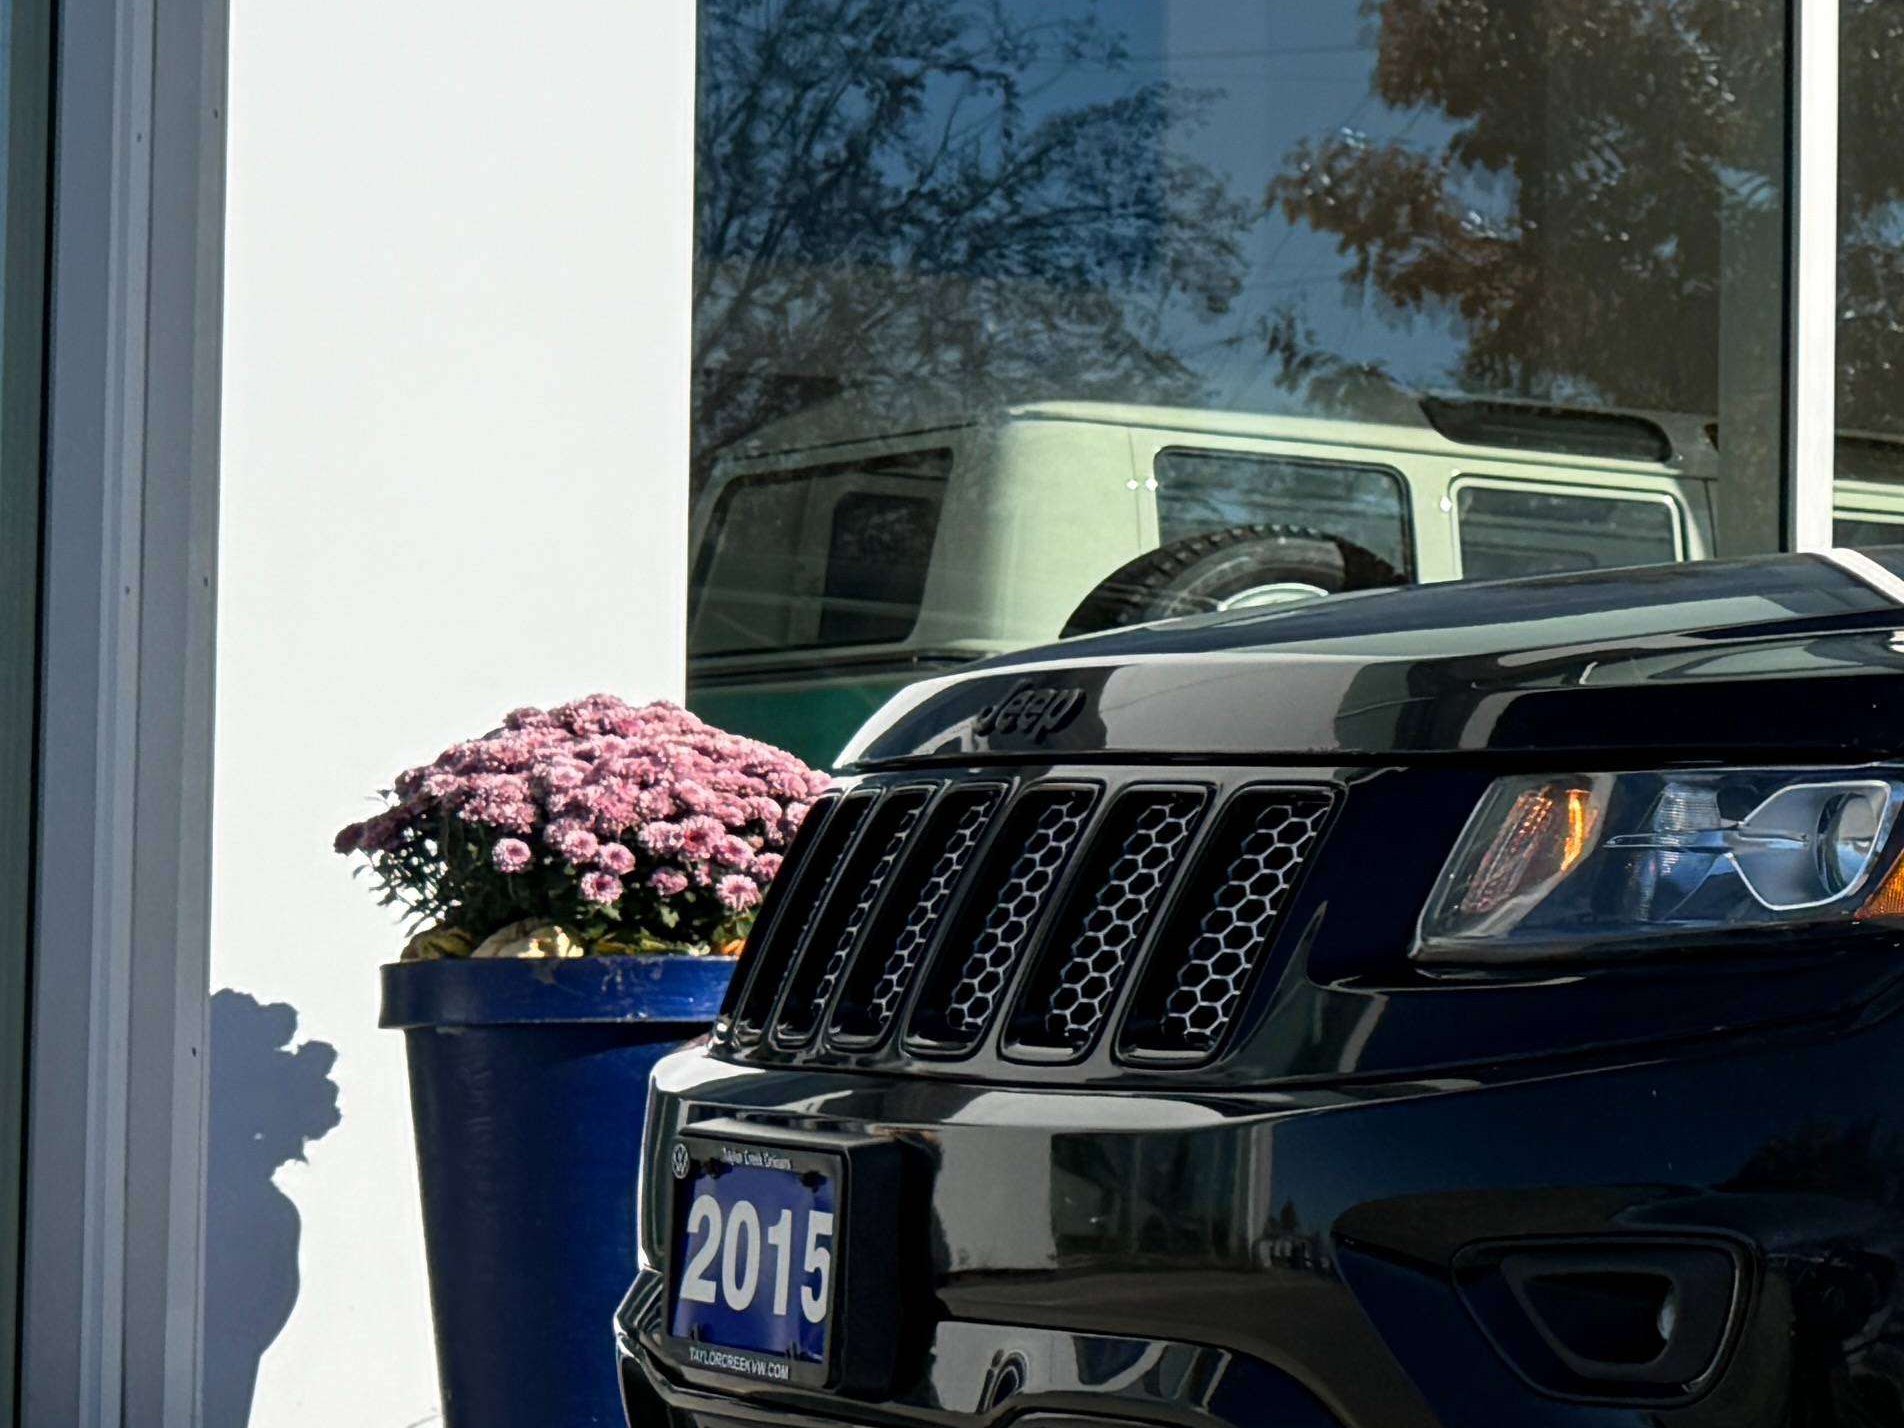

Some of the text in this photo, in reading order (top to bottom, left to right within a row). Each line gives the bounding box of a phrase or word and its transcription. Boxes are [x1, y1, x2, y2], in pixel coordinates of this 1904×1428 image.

[972, 679, 1087, 744] Jeep
[680, 1194, 834, 1324] 2015
[690, 1346, 790, 1381] TAYLORCREEKVW.COM
